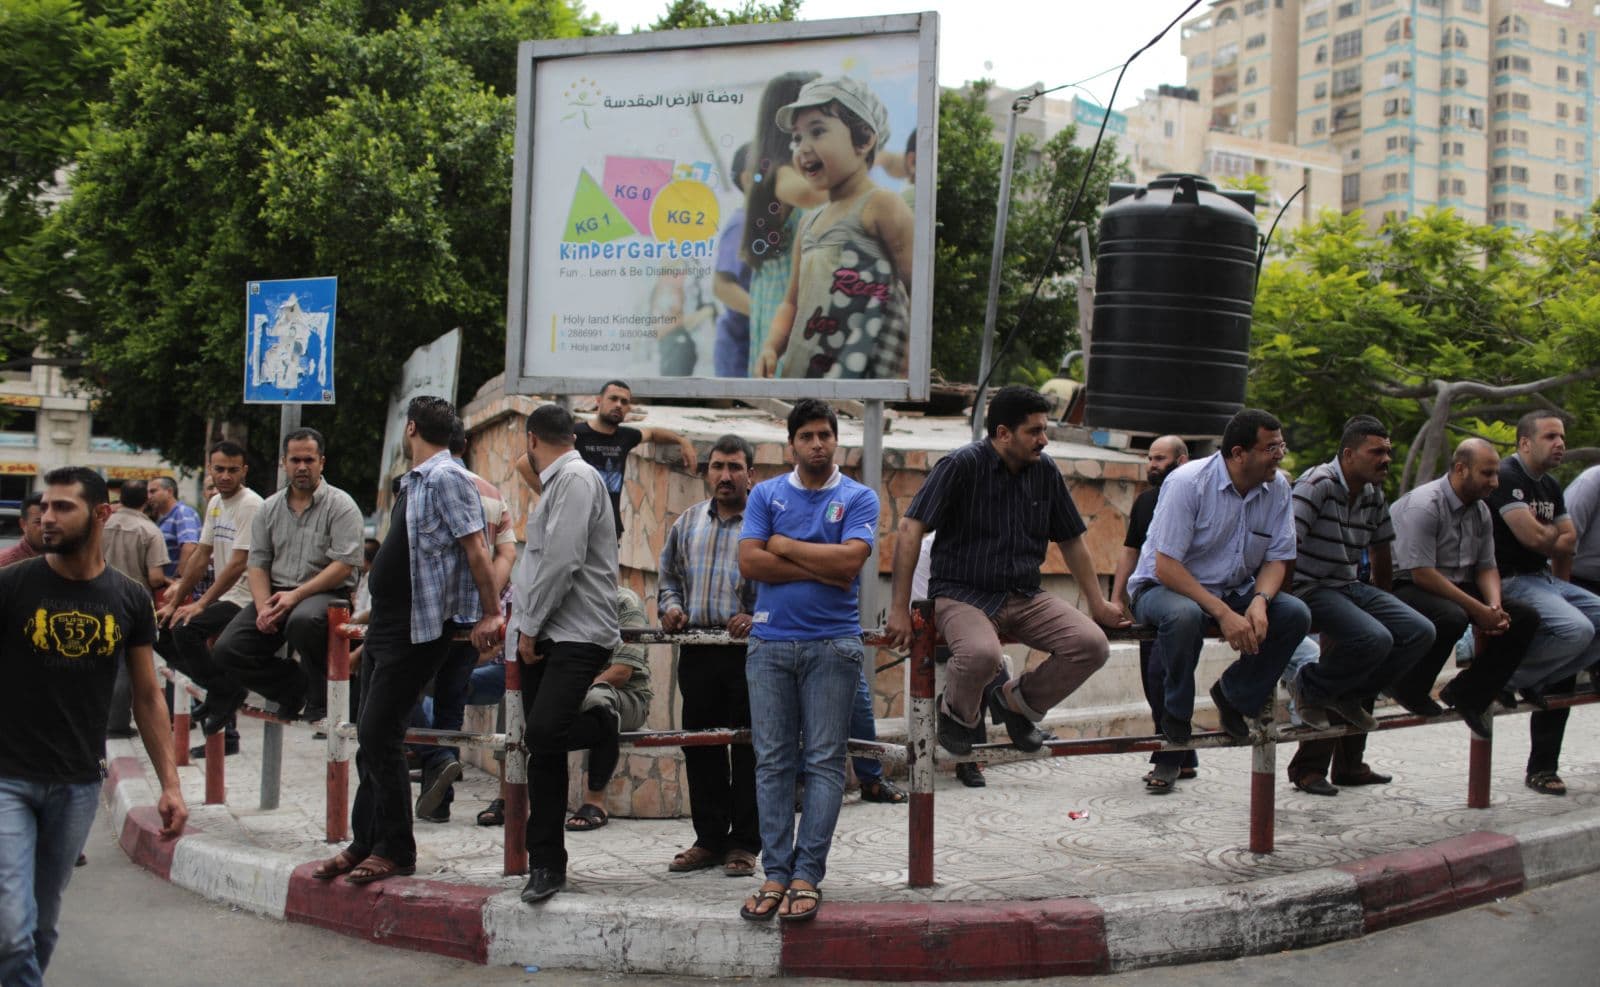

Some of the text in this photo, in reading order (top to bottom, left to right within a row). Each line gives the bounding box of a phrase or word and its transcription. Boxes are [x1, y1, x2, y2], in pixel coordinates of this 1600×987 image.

[603, 94, 663, 109] المقدسة
[706, 90, 744, 105] روضة
[615, 184, 652, 201] KG 0
[575, 213, 611, 236] KG 1
[667, 210, 705, 225] KG 2
[559, 267, 578, 279] Fun
[589, 266, 617, 278] Learn
[619, 267, 627, 277] &
[629, 266, 643, 277] Be
[645, 264, 711, 281] Distinguished
[563, 313, 678, 326] Holy land Kindergarten
[64, 623, 85, 639] 55
